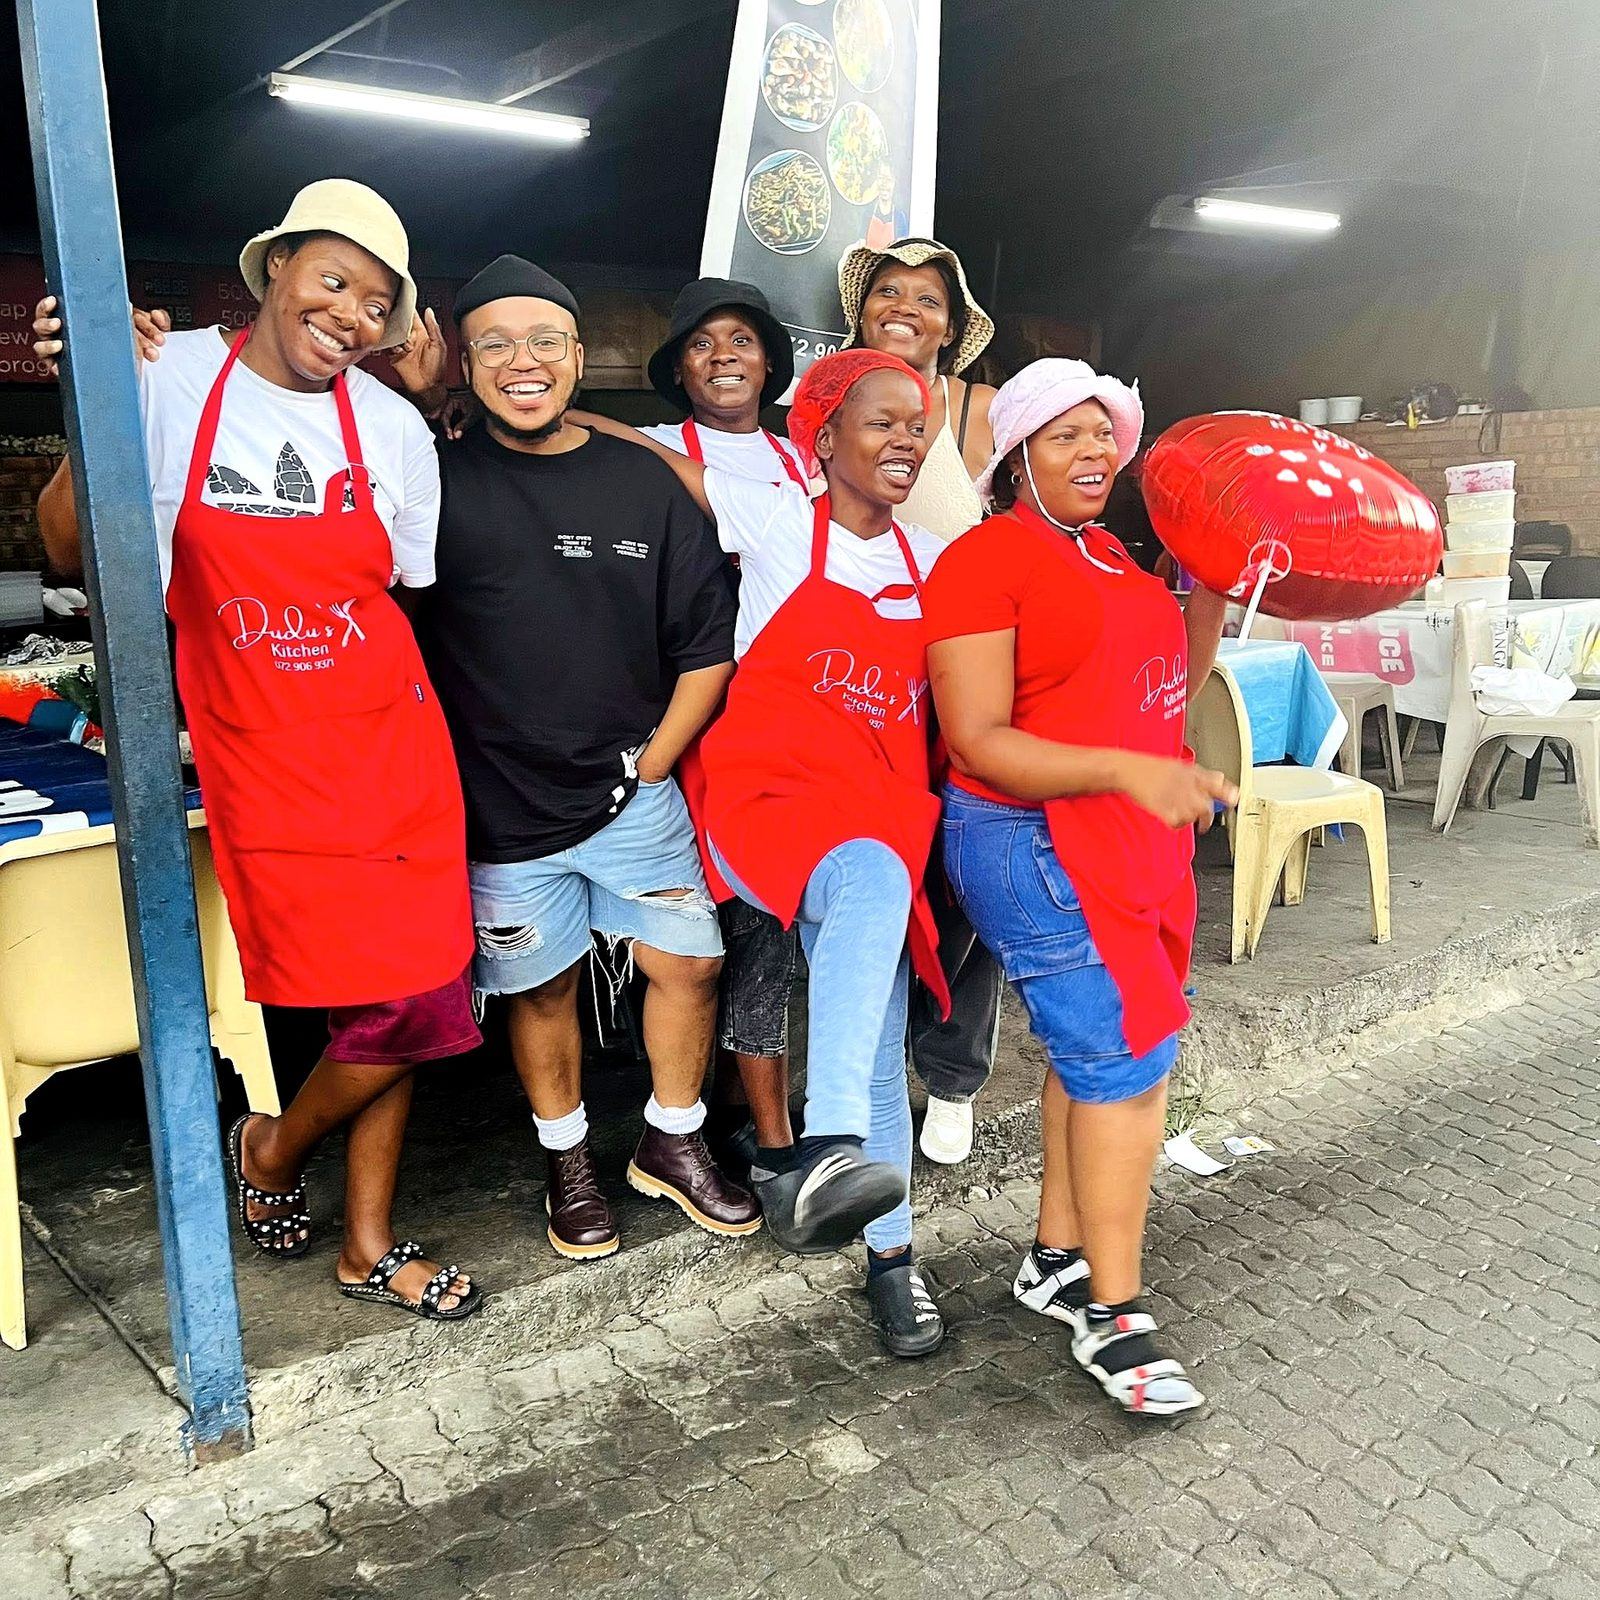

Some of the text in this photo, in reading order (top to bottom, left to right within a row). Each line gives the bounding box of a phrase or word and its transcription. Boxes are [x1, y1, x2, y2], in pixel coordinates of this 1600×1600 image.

[790, 336, 810, 358] 2
[217, 596, 336, 651] Dudu's
[270, 642, 330, 659] Kitchen
[292, 661, 313, 672] 906
[806, 648, 898, 705] Dudu's
